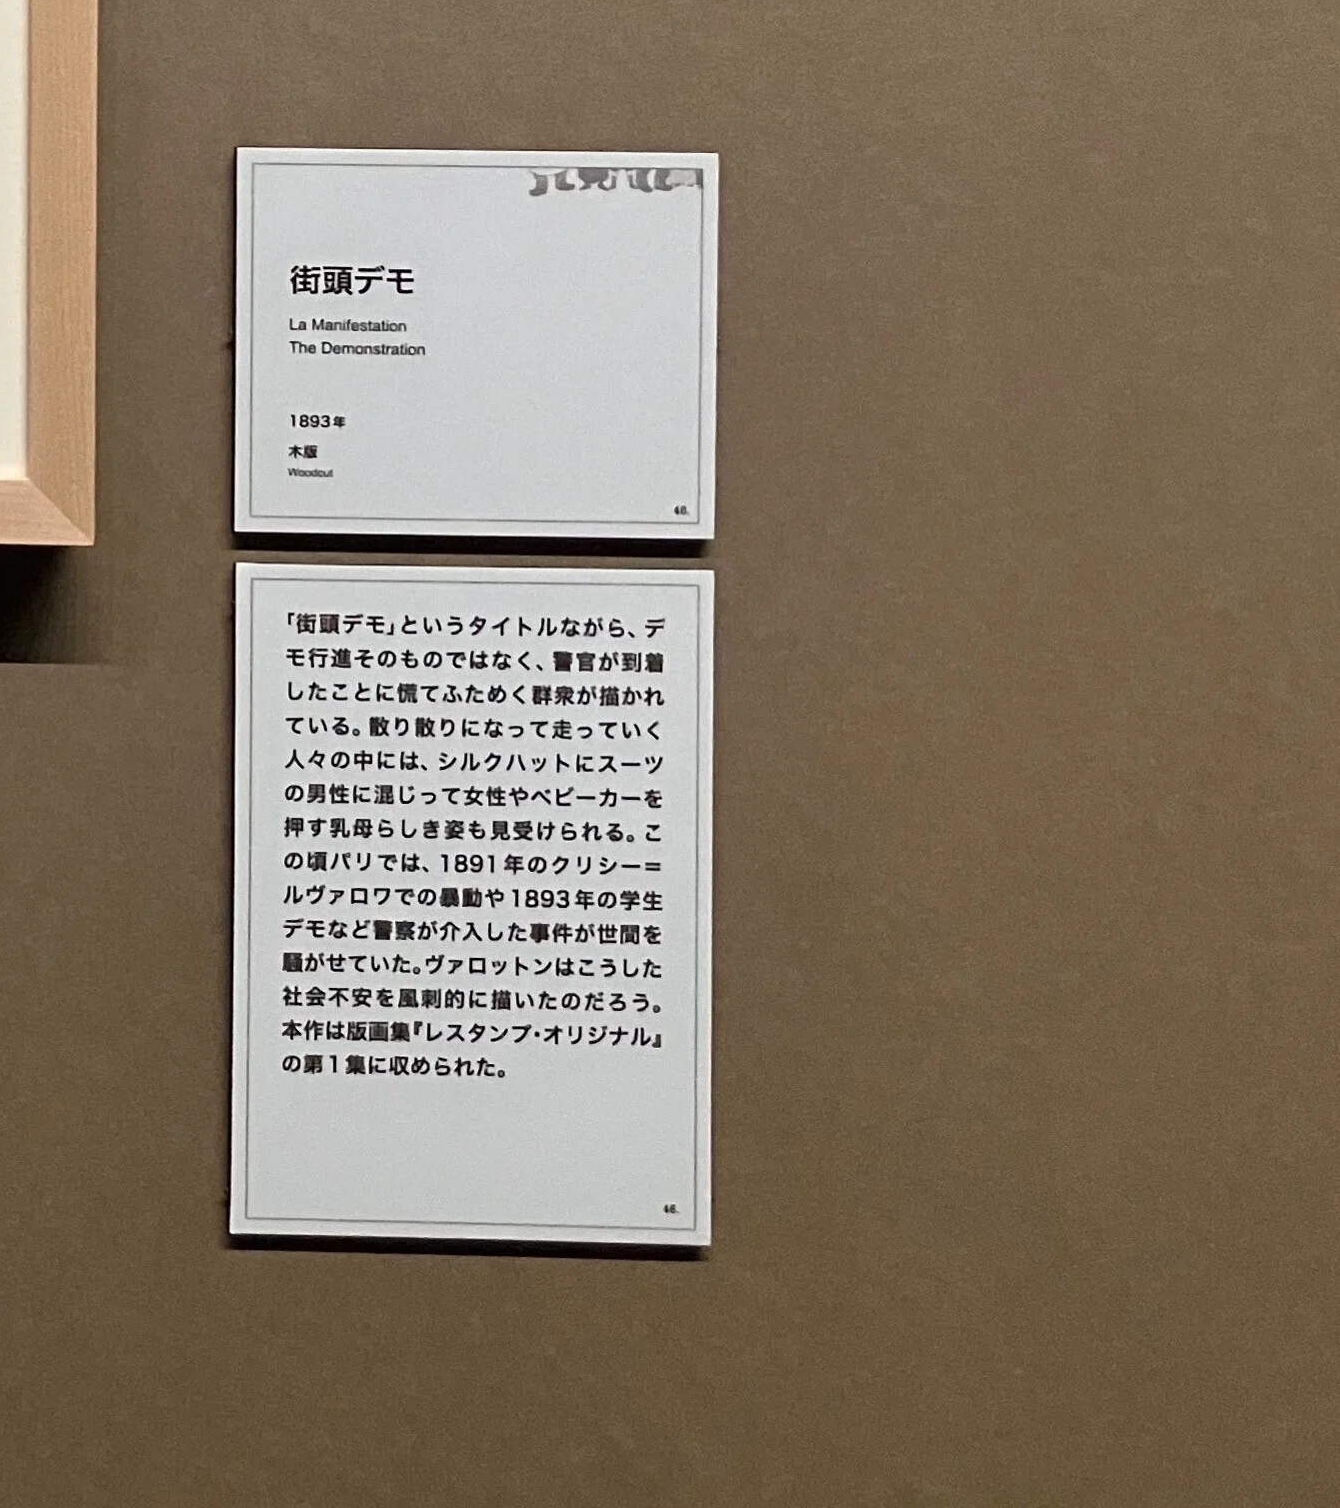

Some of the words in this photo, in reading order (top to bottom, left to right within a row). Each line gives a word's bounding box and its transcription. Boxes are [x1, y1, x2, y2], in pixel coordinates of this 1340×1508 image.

[289, 264, 415, 296] 街頭デモ
[288, 317, 307, 331] La
[311, 317, 408, 333] Manifestation
[288, 340, 317, 354] The
[320, 340, 426, 356] Demonstration
[290, 413, 347, 429] 1893年
[288, 613, 665, 638] 「街頭デモ」というタイトルながら、デ
[286, 648, 663, 673] モ行進そのものではなく、警官が到着
[286, 717, 659, 740] ている。散り散りになって走っていく
[285, 749, 663, 774] 人々の中には、シルクハットにスーツ
[285, 784, 662, 808] の男性に混じって女性やベビーカーを
[284, 817, 661, 842] 押す乳母らしき姿も見受けられる。こ
[283, 986, 660, 1013] 社会不安を風刺的に描いたのだろう。
